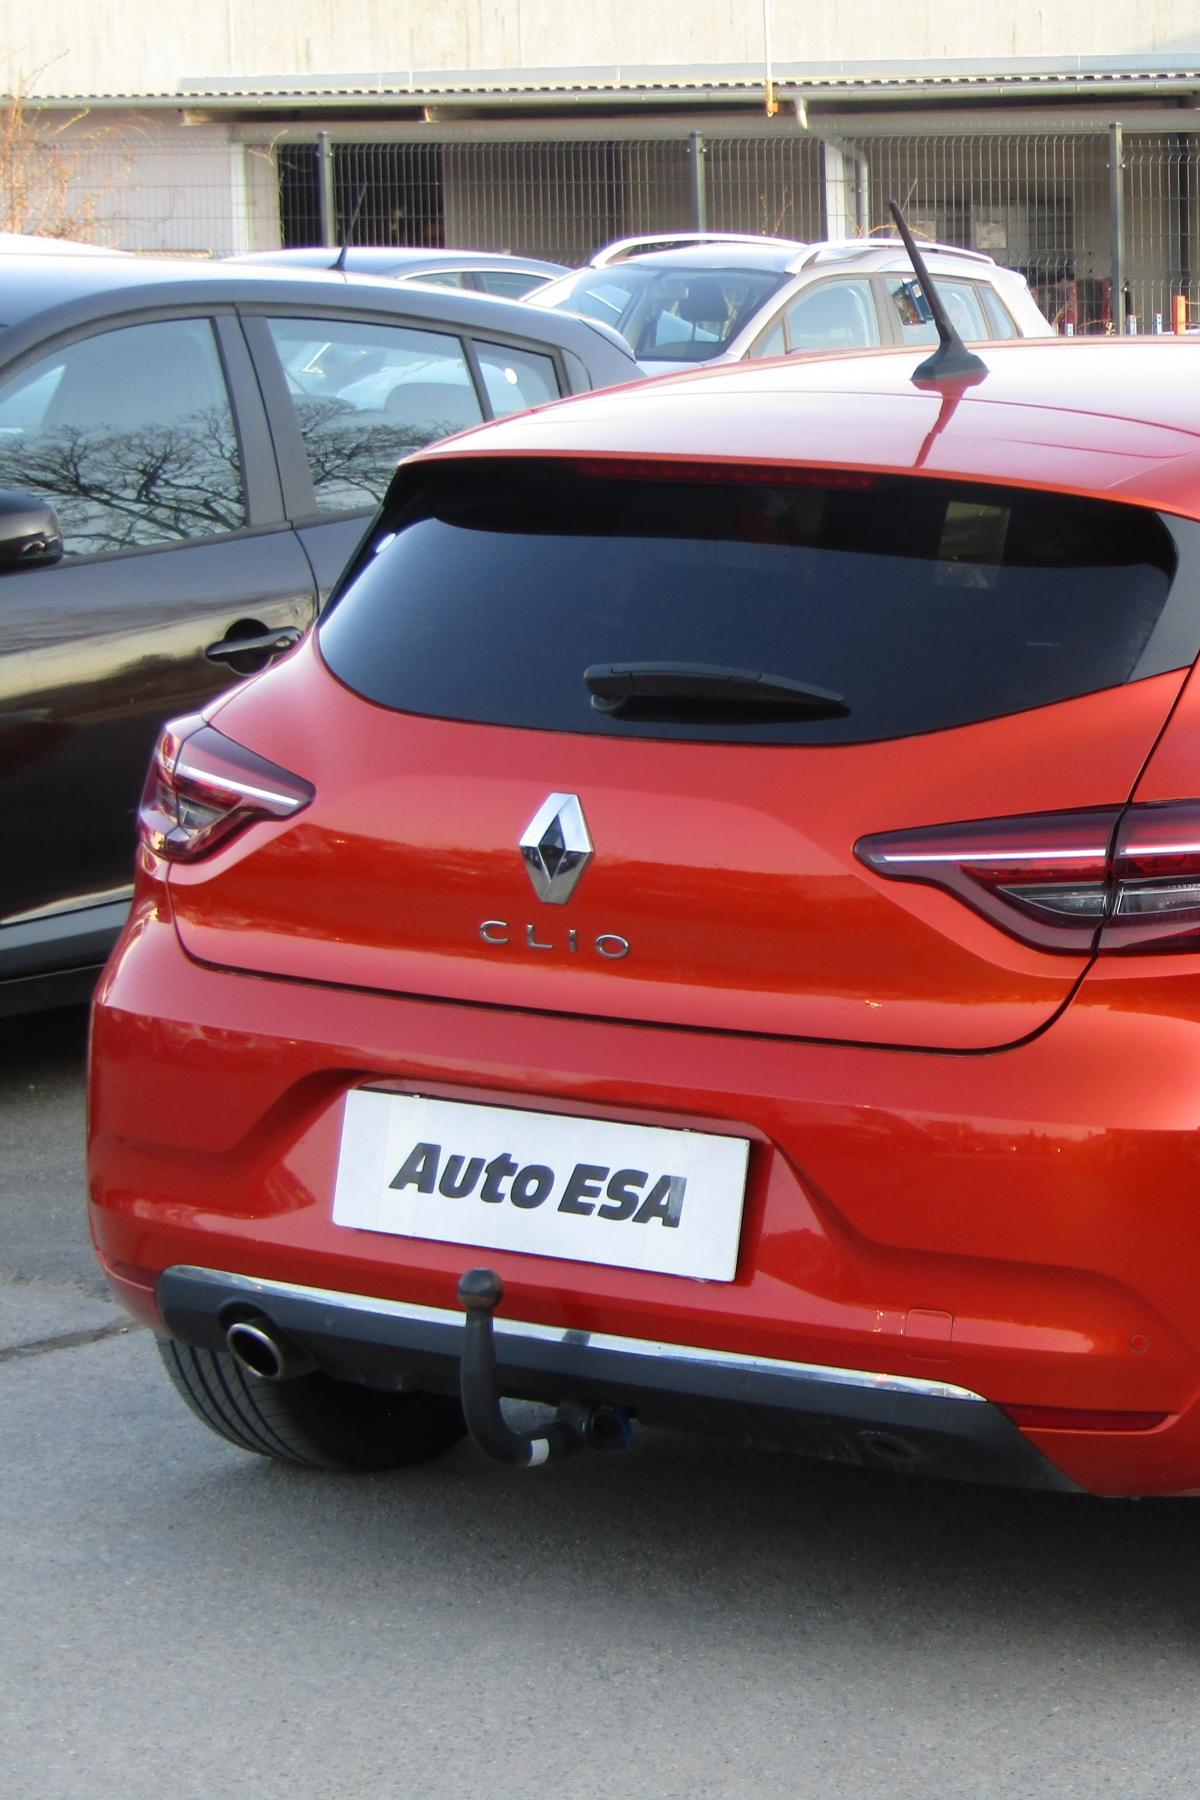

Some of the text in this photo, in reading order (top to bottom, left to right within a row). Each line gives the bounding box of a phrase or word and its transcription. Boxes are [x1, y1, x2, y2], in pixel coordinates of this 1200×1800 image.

[480, 920, 630, 959] CLIO
[388, 1142, 687, 1228] Auto ESA
